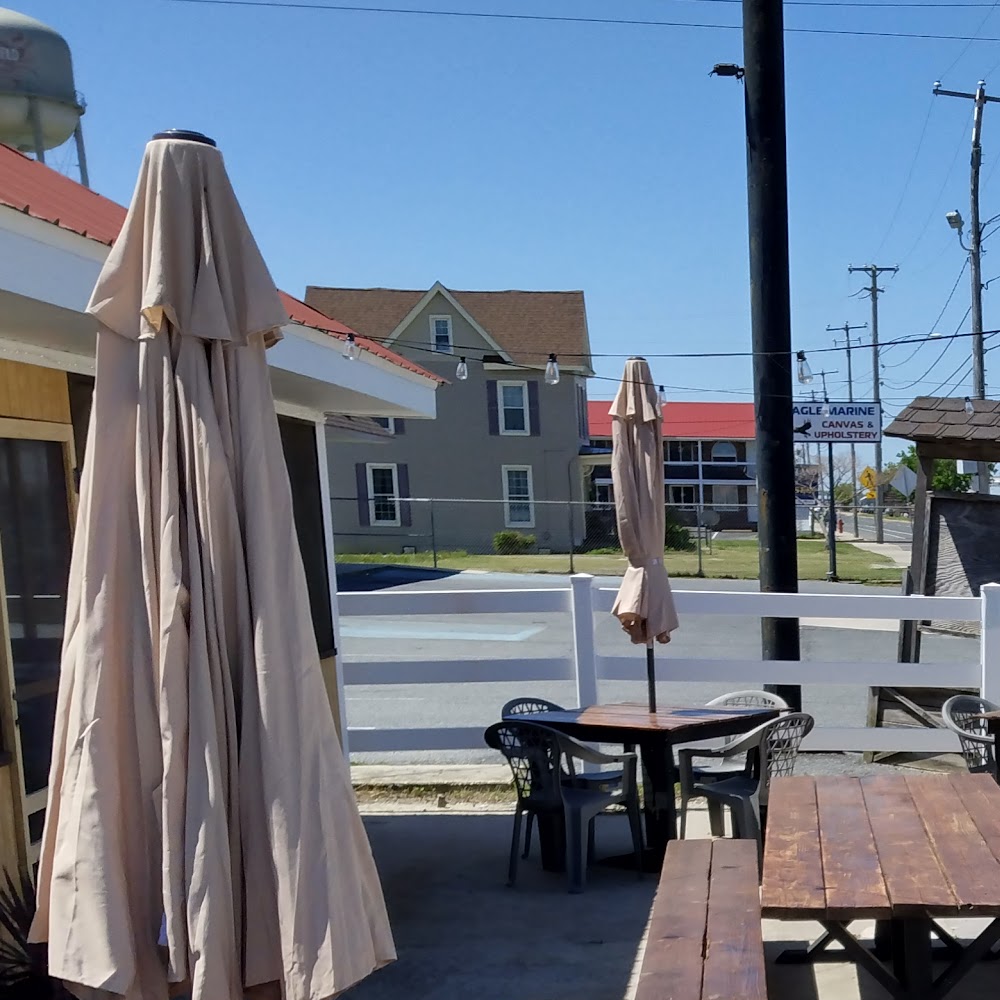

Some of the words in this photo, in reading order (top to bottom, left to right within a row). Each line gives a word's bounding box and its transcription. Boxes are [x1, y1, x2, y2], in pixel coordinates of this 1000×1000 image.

[793, 406, 822, 416] AGLE
[829, 406, 875, 416] MARINE
[821, 420, 864, 429] CANVAS
[867, 421, 874, 429] &
[814, 431, 878, 439] UPHOLSTERY
